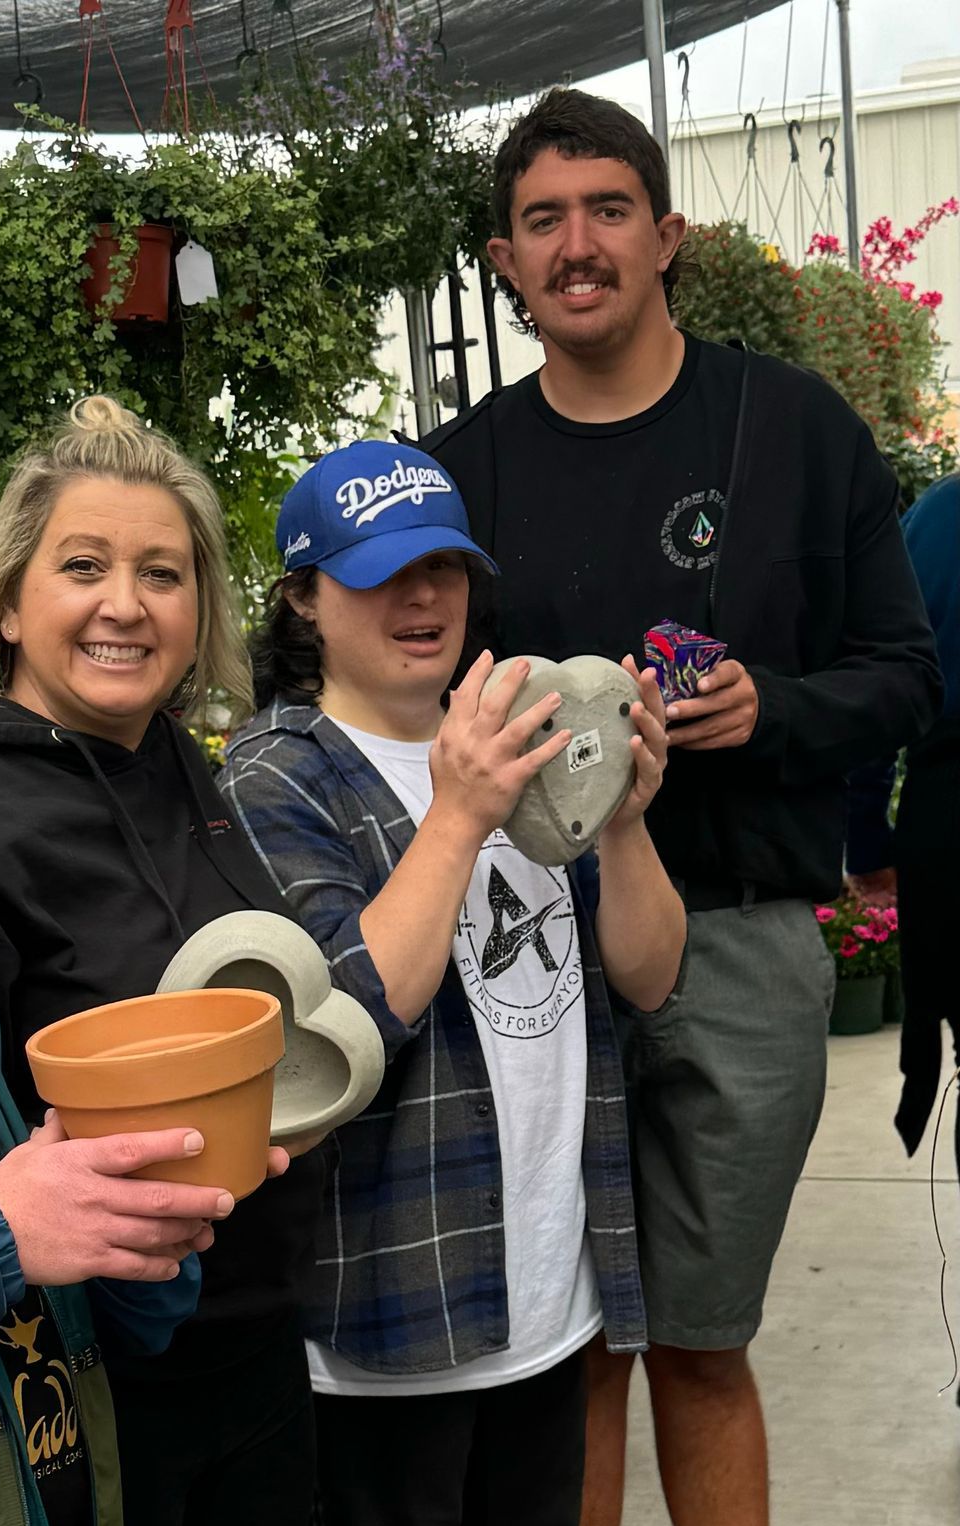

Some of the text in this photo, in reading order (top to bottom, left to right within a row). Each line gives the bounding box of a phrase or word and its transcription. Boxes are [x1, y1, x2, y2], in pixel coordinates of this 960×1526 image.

[336, 460, 451, 526] Dodgers
[506, 1015, 537, 1031] FOR
[541, 945, 583, 1029] EVERYON
[33, 1460, 63, 1480] SICAL
